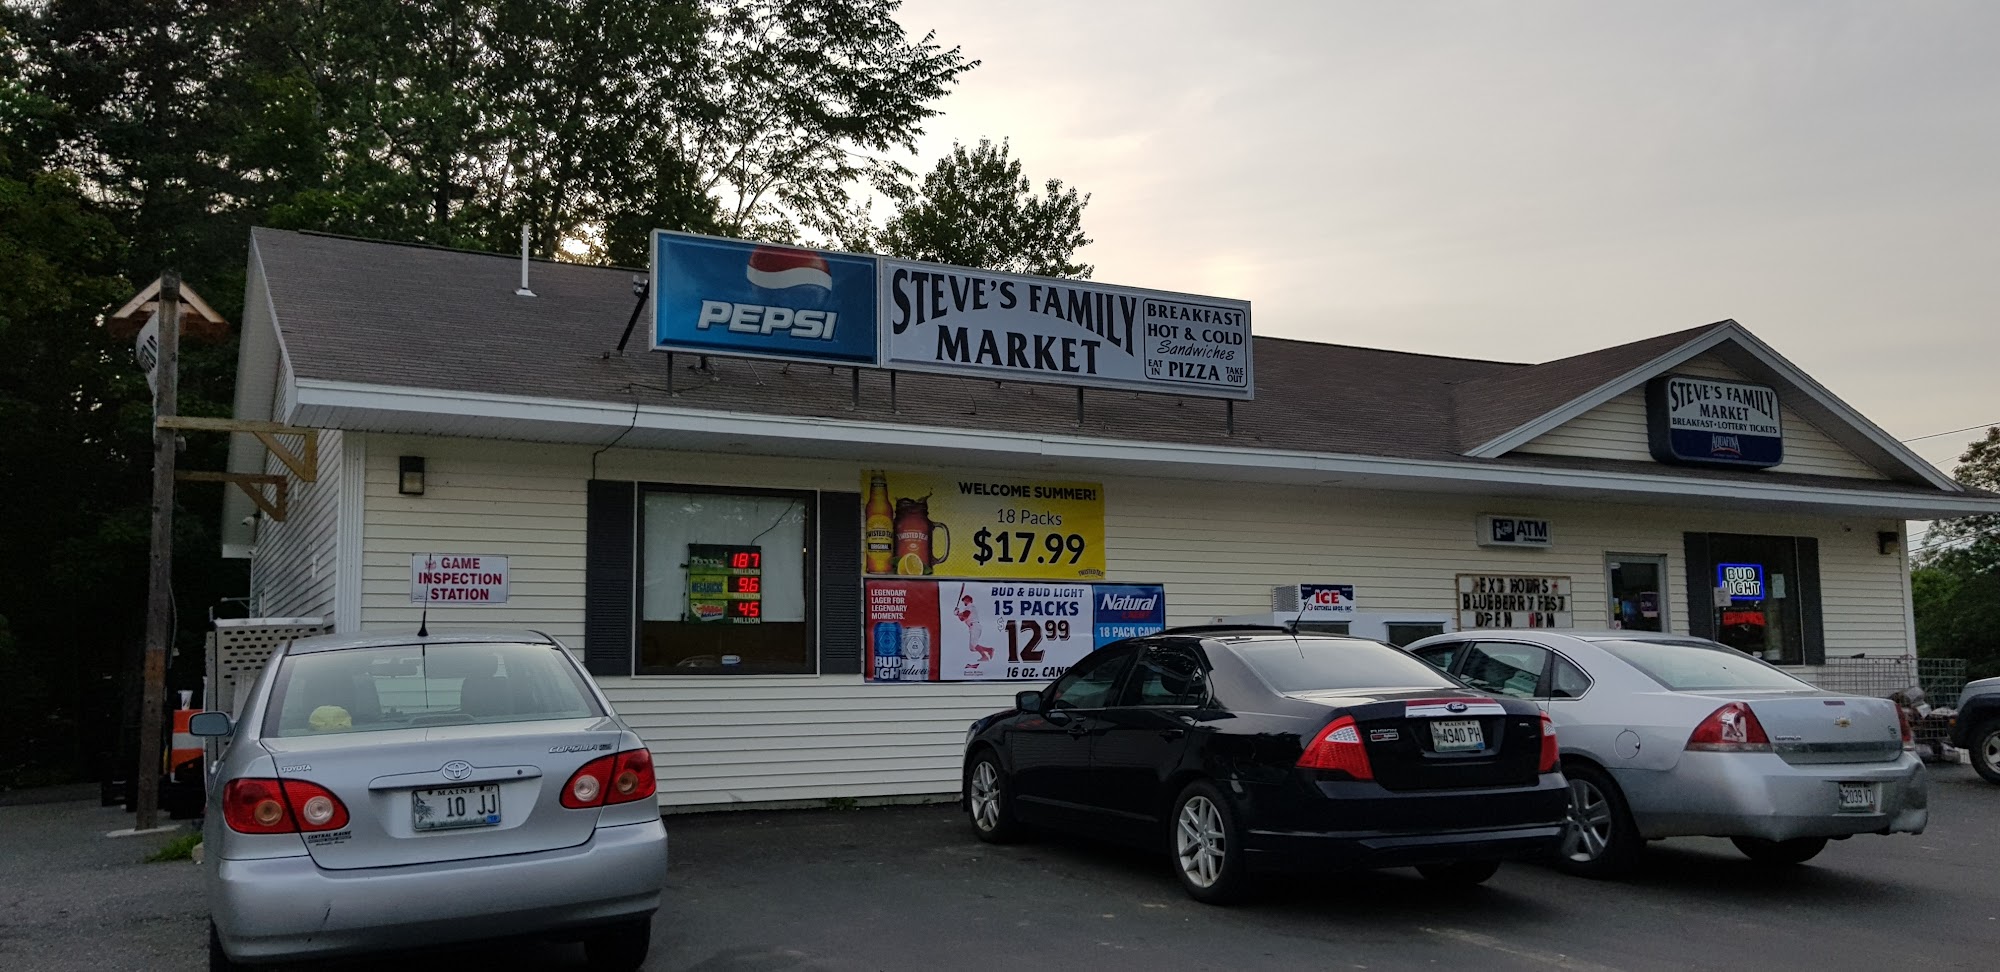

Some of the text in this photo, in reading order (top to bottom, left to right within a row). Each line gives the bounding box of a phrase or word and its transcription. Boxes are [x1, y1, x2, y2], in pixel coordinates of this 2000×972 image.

[892, 268, 1137, 357] STEVE'S FAMILY
[1147, 303, 1241, 326] BREAKFAST
[697, 300, 838, 341] PEPSI
[1147, 323, 1242, 345] HOT & COLD
[936, 325, 1101, 374] MARKET
[1157, 340, 1234, 360] Sandwiches
[1148, 359, 1163, 367] EAT
[1226, 366, 1243, 375] TAKE
[1168, 361, 1220, 381] PIZZA
[1227, 375, 1242, 383] OUT
[1670, 381, 1774, 420] STEVE'S FAMILY
[1700, 403, 1748, 421] MARKET
[1672, 417, 1777, 434] BREAKFAST LOTTERY TICKETS
[958, 482, 1096, 501] WELCOME SUMMER!
[997, 509, 1062, 525] 18 Packs
[1516, 521, 1547, 537] ATM
[972, 526, 1085, 566] $17.99
[441, 557, 480, 569] GAME
[732, 553, 760, 568] 187
[418, 572, 502, 585] INSPECTION
[1726, 567, 1755, 581] BUD
[739, 577, 759, 592] 9.6
[431, 588, 489, 600] STATION
[991, 587, 1085, 598] BUD & BUD LIGHT
[1315, 591, 1340, 604] ICE
[739, 602, 759, 616] 45
[994, 600, 1079, 616] 15 PACKS
[1100, 593, 1158, 611] Natural
[1463, 593, 1565, 611] BLUEBERRY FEST
[871, 612, 905, 620] MOMENTS.
[1475, 612, 1512, 627] OPEN
[1099, 627, 1110, 637] 18
[1112, 627, 1136, 637] PACK
[875, 656, 902, 668] BUD
[874, 668, 900, 680] IGH
[1006, 667, 1019, 678] 16
[1443, 727, 1481, 743] 4940 PH
[549, 744, 597, 754] COROLLA
[282, 764, 311, 772] TOYOTA
[438, 787, 476, 796] MAINE
[1845, 789, 1862, 804] 2039
[447, 794, 496, 818] 10 JJ
[308, 832, 331, 840] CENTRAL
